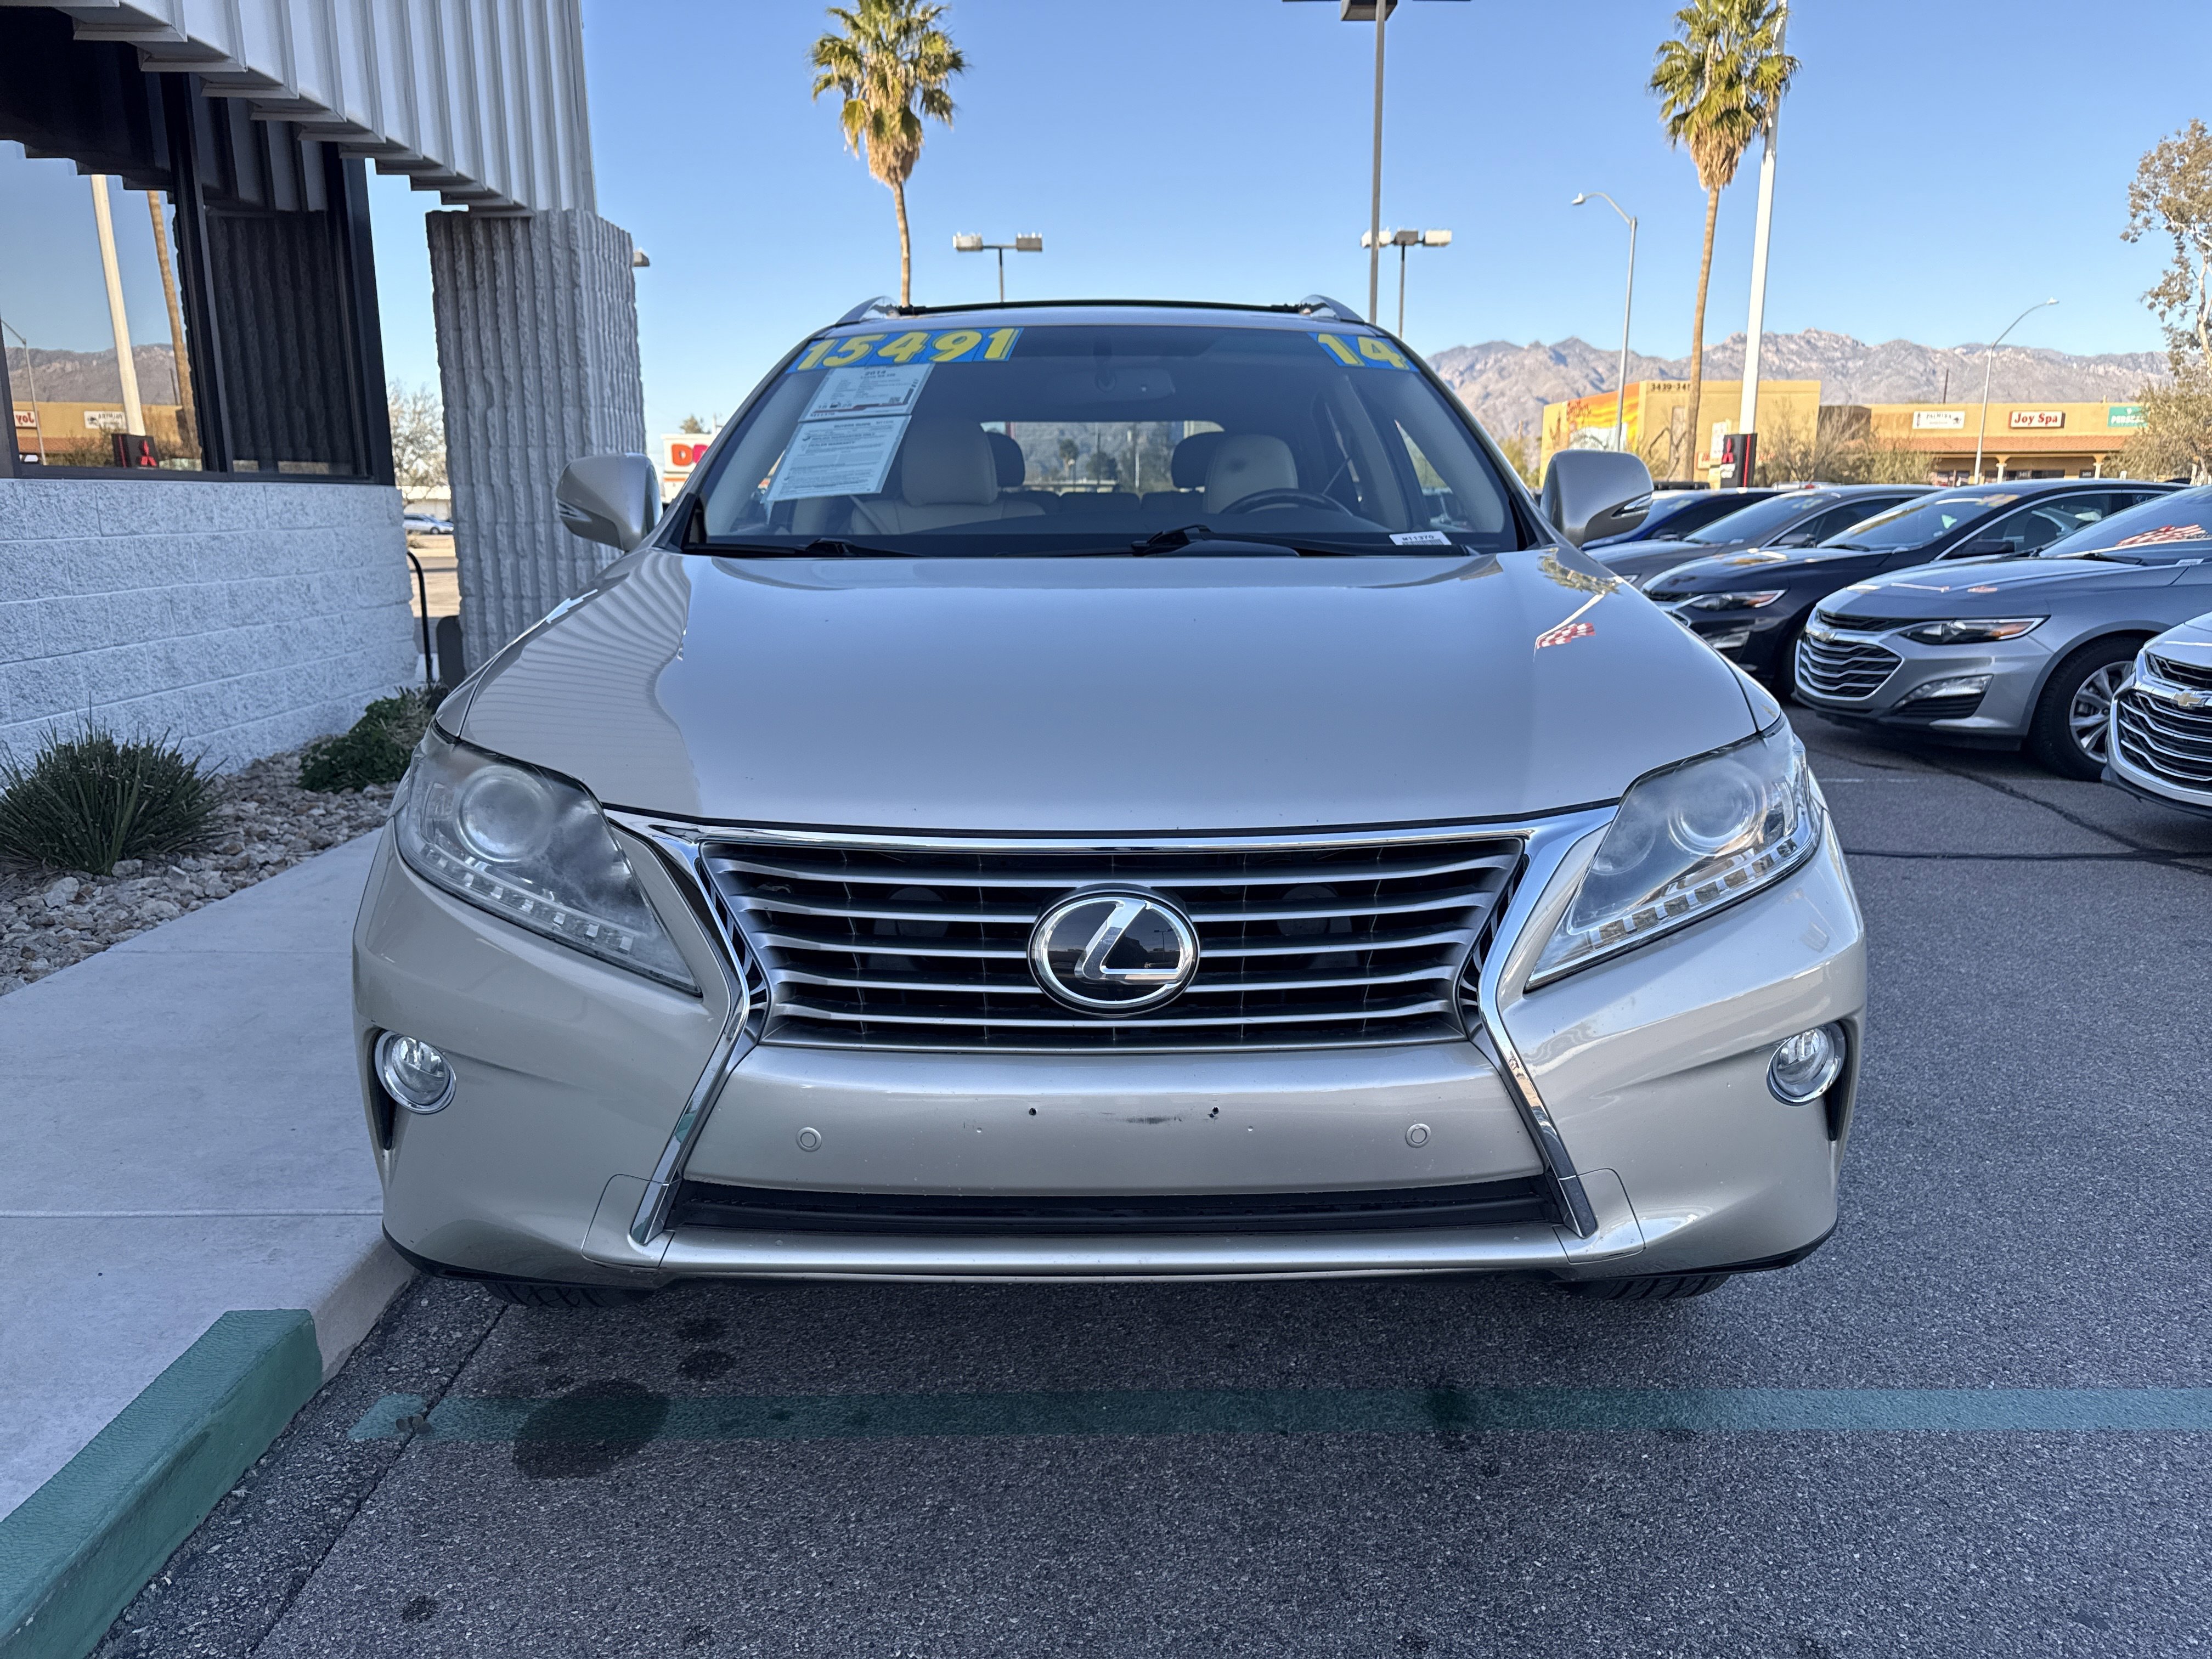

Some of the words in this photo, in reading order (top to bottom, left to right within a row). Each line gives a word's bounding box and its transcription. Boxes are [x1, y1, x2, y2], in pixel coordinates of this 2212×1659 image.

[797, 328, 1019, 371] 15491
[1318, 333, 1410, 370] 14
[2014, 412, 2034, 426] Joy
[2038, 412, 2058, 426] Spa
